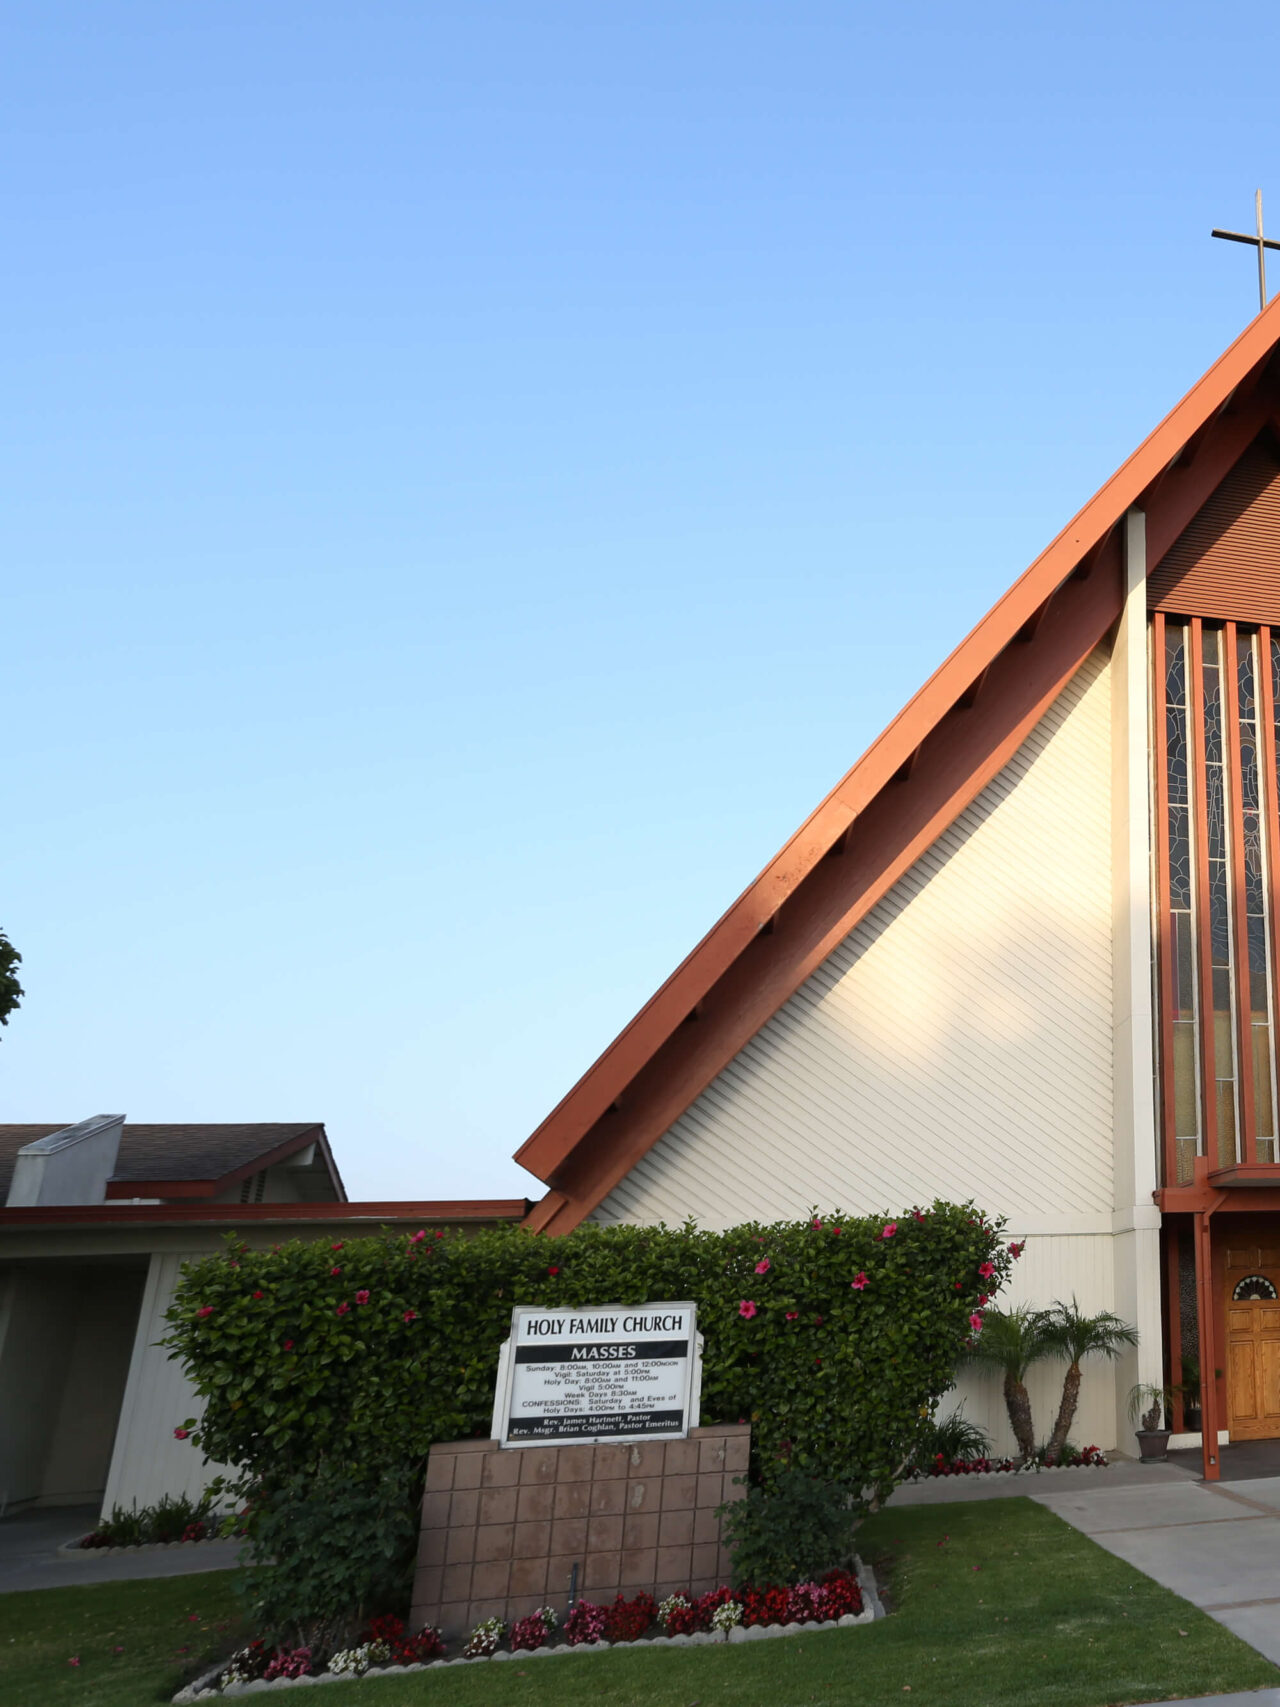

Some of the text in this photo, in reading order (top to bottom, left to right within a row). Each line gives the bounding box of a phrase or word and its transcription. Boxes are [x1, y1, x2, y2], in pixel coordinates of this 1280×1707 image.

[527, 1315, 682, 1336] HOLY FAMILY CHURCH
[571, 1345, 636, 1360] MASSES
[522, 1399, 581, 1407] CONFESSIONS:
[563, 1417, 586, 1425] James
[589, 1415, 624, 1424] Hartnett,
[627, 1414, 651, 1422] Pastor
[533, 1427, 556, 1435] Msgr.
[582, 1424, 616, 1432] Coghlan,
[619, 1422, 643, 1430] Pastor
[645, 1420, 679, 1428] Emeritus
